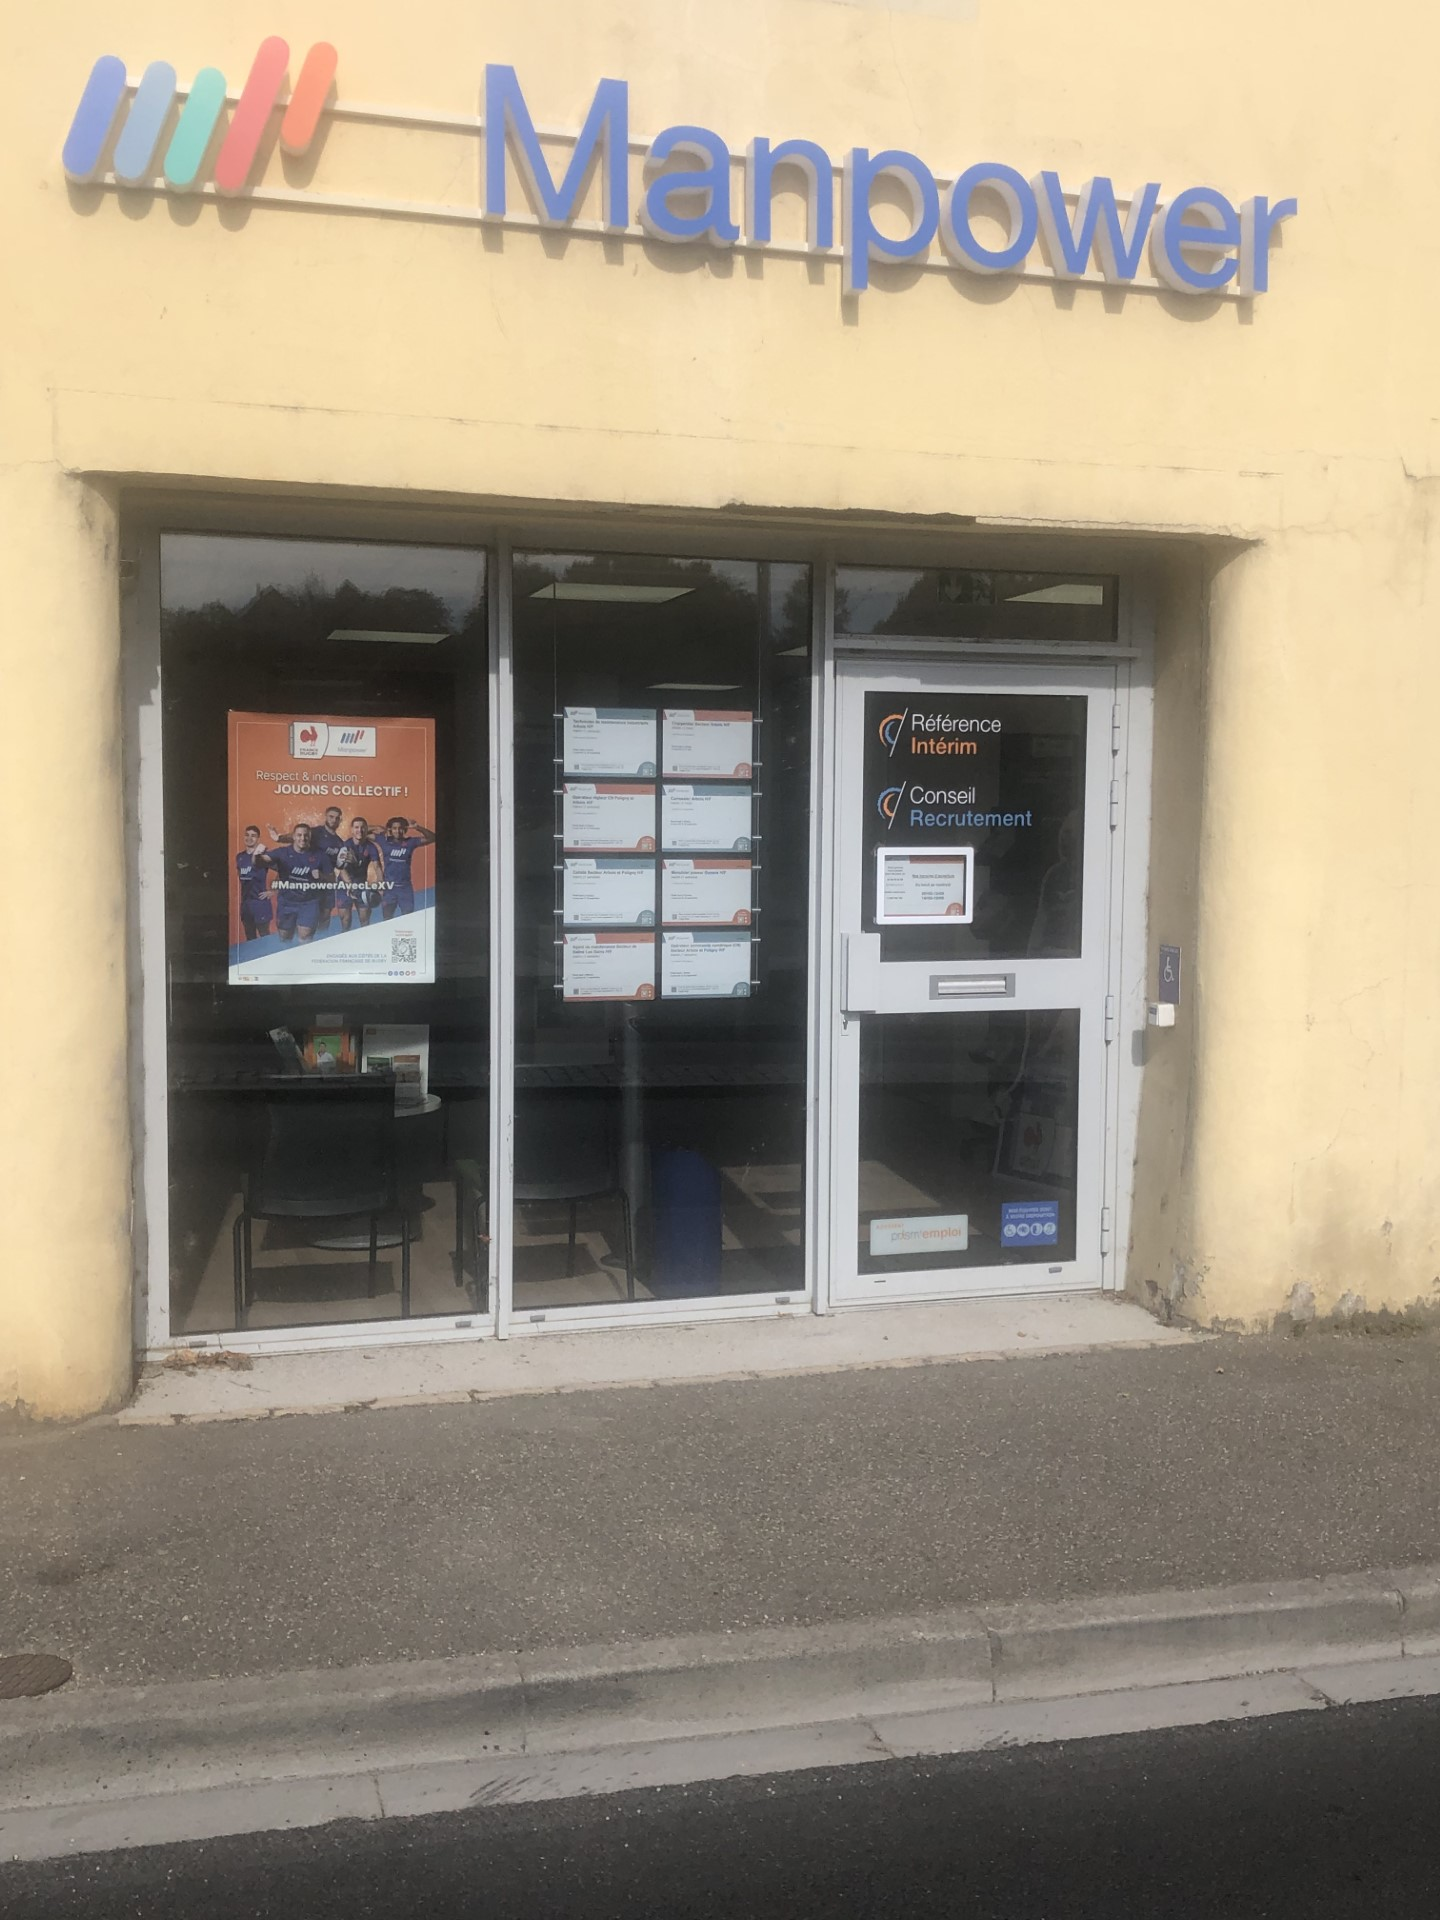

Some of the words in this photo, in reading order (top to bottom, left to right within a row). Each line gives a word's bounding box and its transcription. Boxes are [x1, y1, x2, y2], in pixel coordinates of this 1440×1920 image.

[482, 63, 1298, 294] Manpower
[911, 713, 1001, 733] Référence
[911, 736, 977, 755] Intérim
[256, 770, 299, 783] Respect
[302, 771, 310, 781] &
[312, 772, 357, 783] inclusion
[274, 784, 329, 795] JOUONS
[332, 785, 401, 797] COLLECTIF
[909, 785, 975, 805] Conseil
[909, 809, 1032, 828] Recrutement
[271, 880, 395, 892] #ManpowerAvecLeXV
